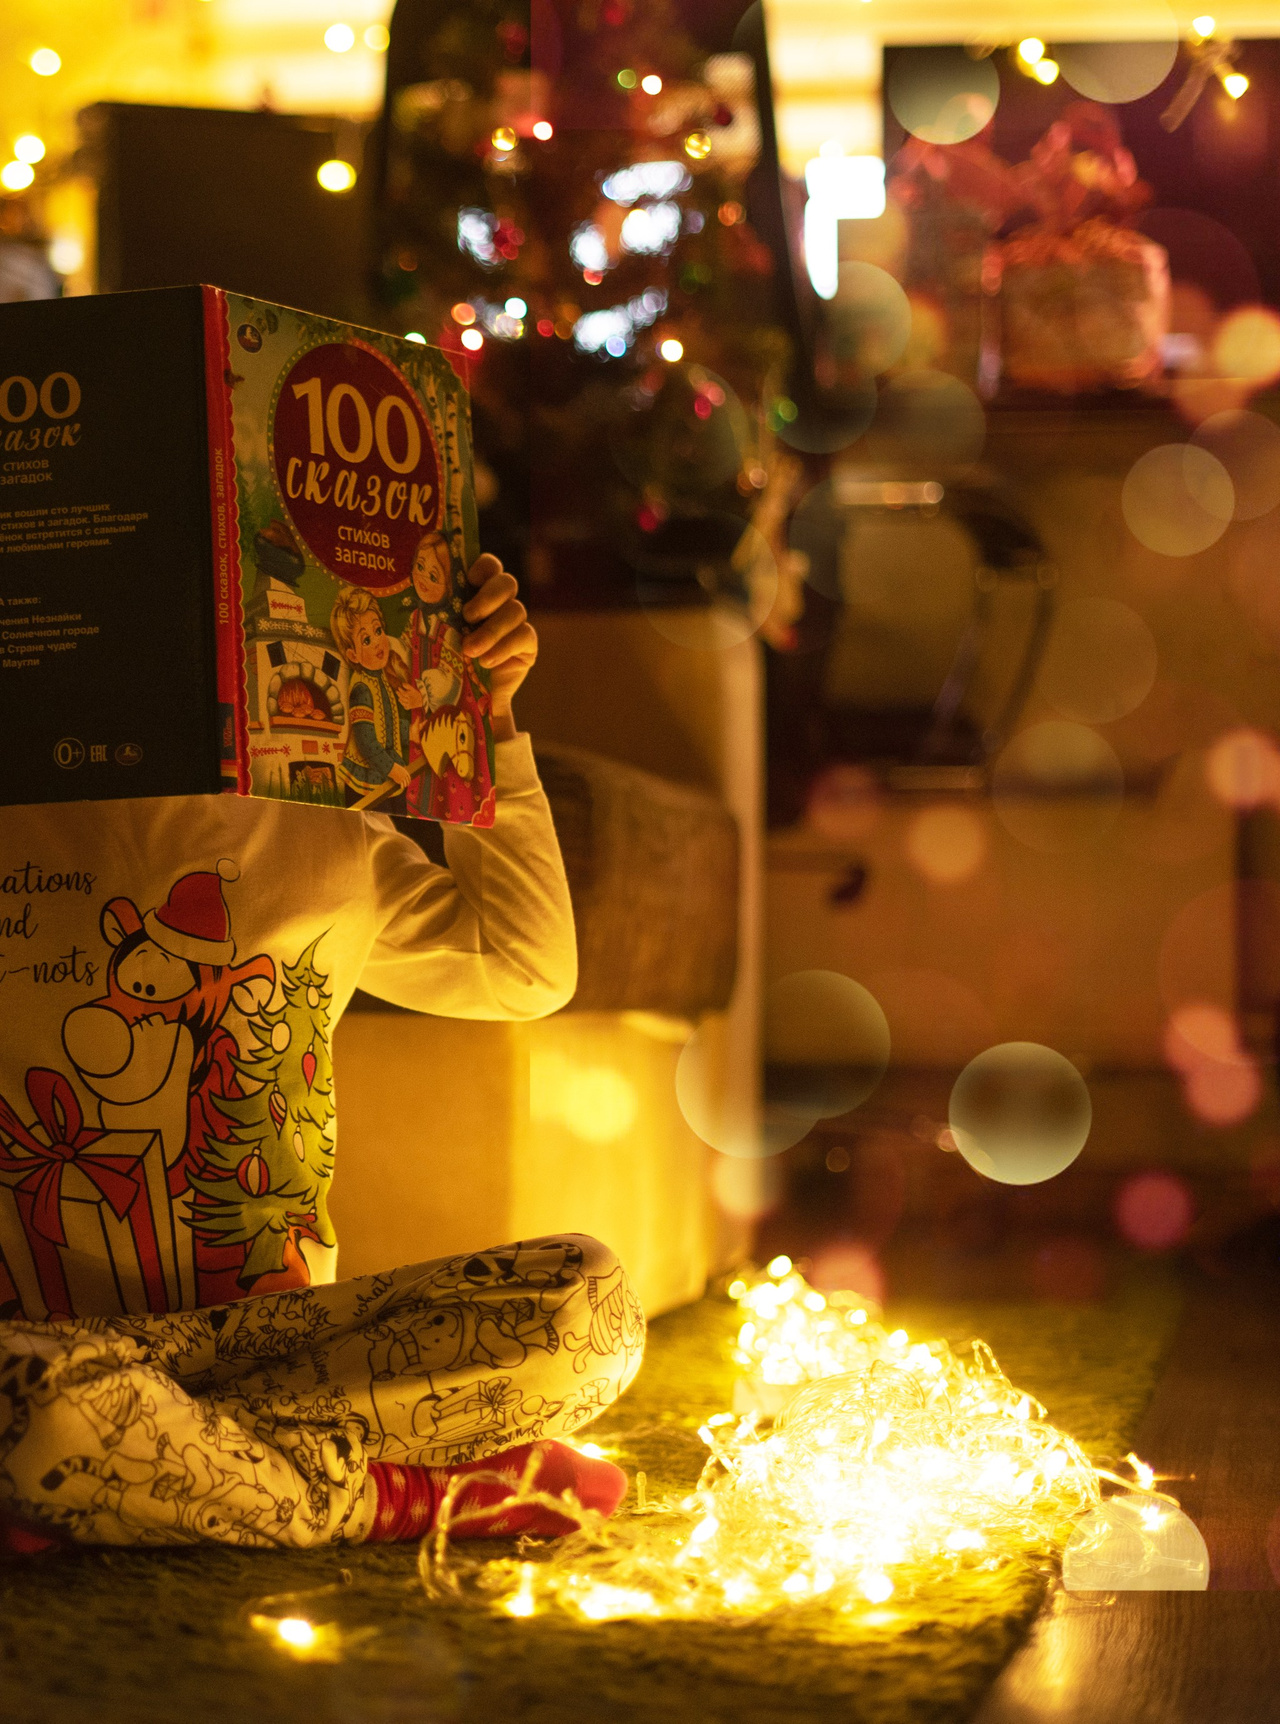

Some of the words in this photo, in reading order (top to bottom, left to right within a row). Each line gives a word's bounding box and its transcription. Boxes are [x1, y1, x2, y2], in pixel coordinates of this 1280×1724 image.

[291, 377, 421, 474] 100
[2, 459, 50, 472] стихов
[213, 447, 225, 499] загадок
[0, 472, 53, 486] загадок
[286, 457, 434, 526] сказок
[14, 508, 48, 518] вошли
[51, 507, 68, 515] сто
[70, 503, 111, 515] лучших
[1, 520, 36, 531] стихов
[93, 512, 149, 524] Благодаря
[215, 502, 227, 549] стихов,
[25, 528, 83, 541] встретится
[84, 528, 91, 536] с
[93, 524, 137, 535] самыми
[337, 525, 391, 549] стихов
[6, 541, 64, 554] любимыми
[334, 546, 396, 573] загадок
[217, 553, 229, 600] сказок,
[31, 612, 82, 624] Незнайки
[218, 603, 229, 625] 100
[1, 628, 60, 641] Солнечном
[62, 625, 100, 637] городе
[0, 646, 5, 655] в
[7, 643, 45, 655] Стране
[47, 641, 78, 652] чудес
[2, 658, 40, 669] Маугли
[57, 743, 82, 765] 0+
